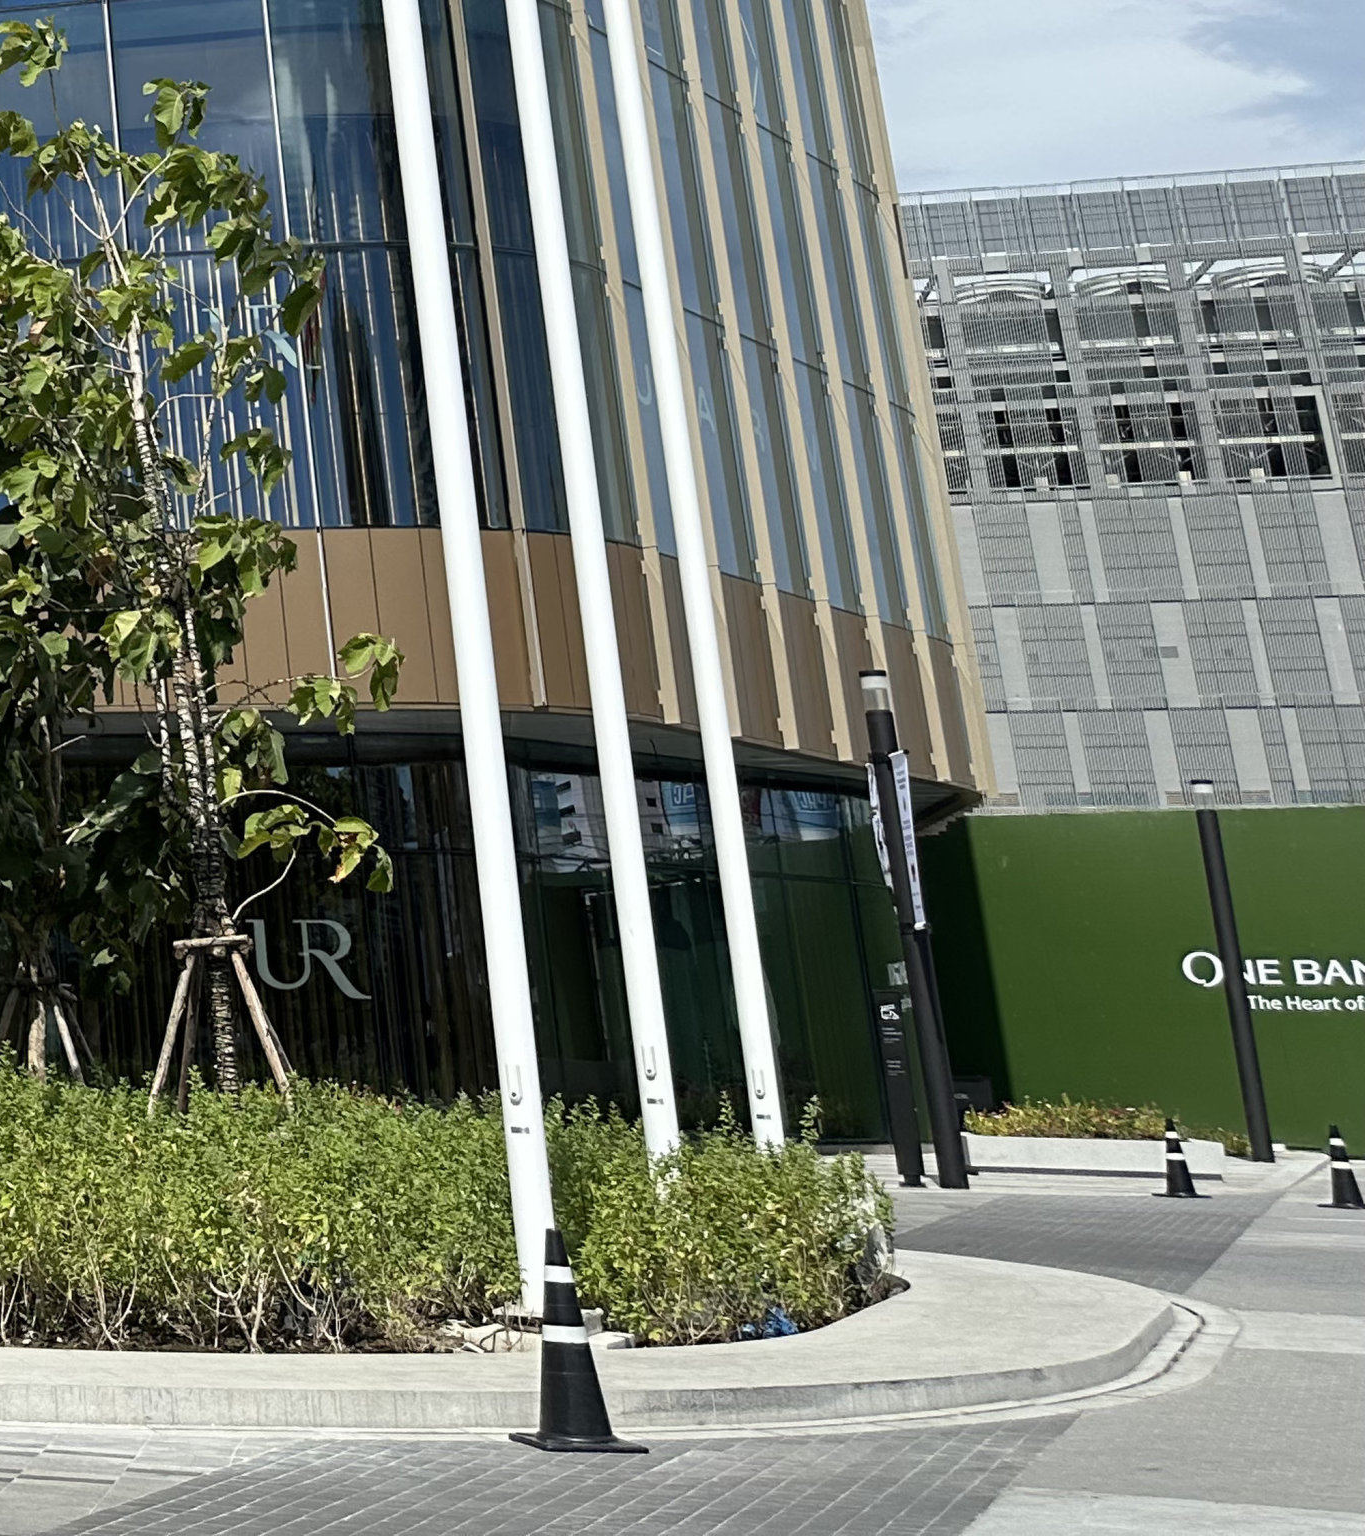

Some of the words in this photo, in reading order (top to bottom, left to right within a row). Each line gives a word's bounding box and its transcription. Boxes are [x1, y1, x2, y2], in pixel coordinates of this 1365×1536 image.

[245, 918, 372, 1000] UR
[1246, 995, 1283, 1011] The
[1285, 995, 1342, 1012] Heart
[1344, 995, 1365, 1011] of
